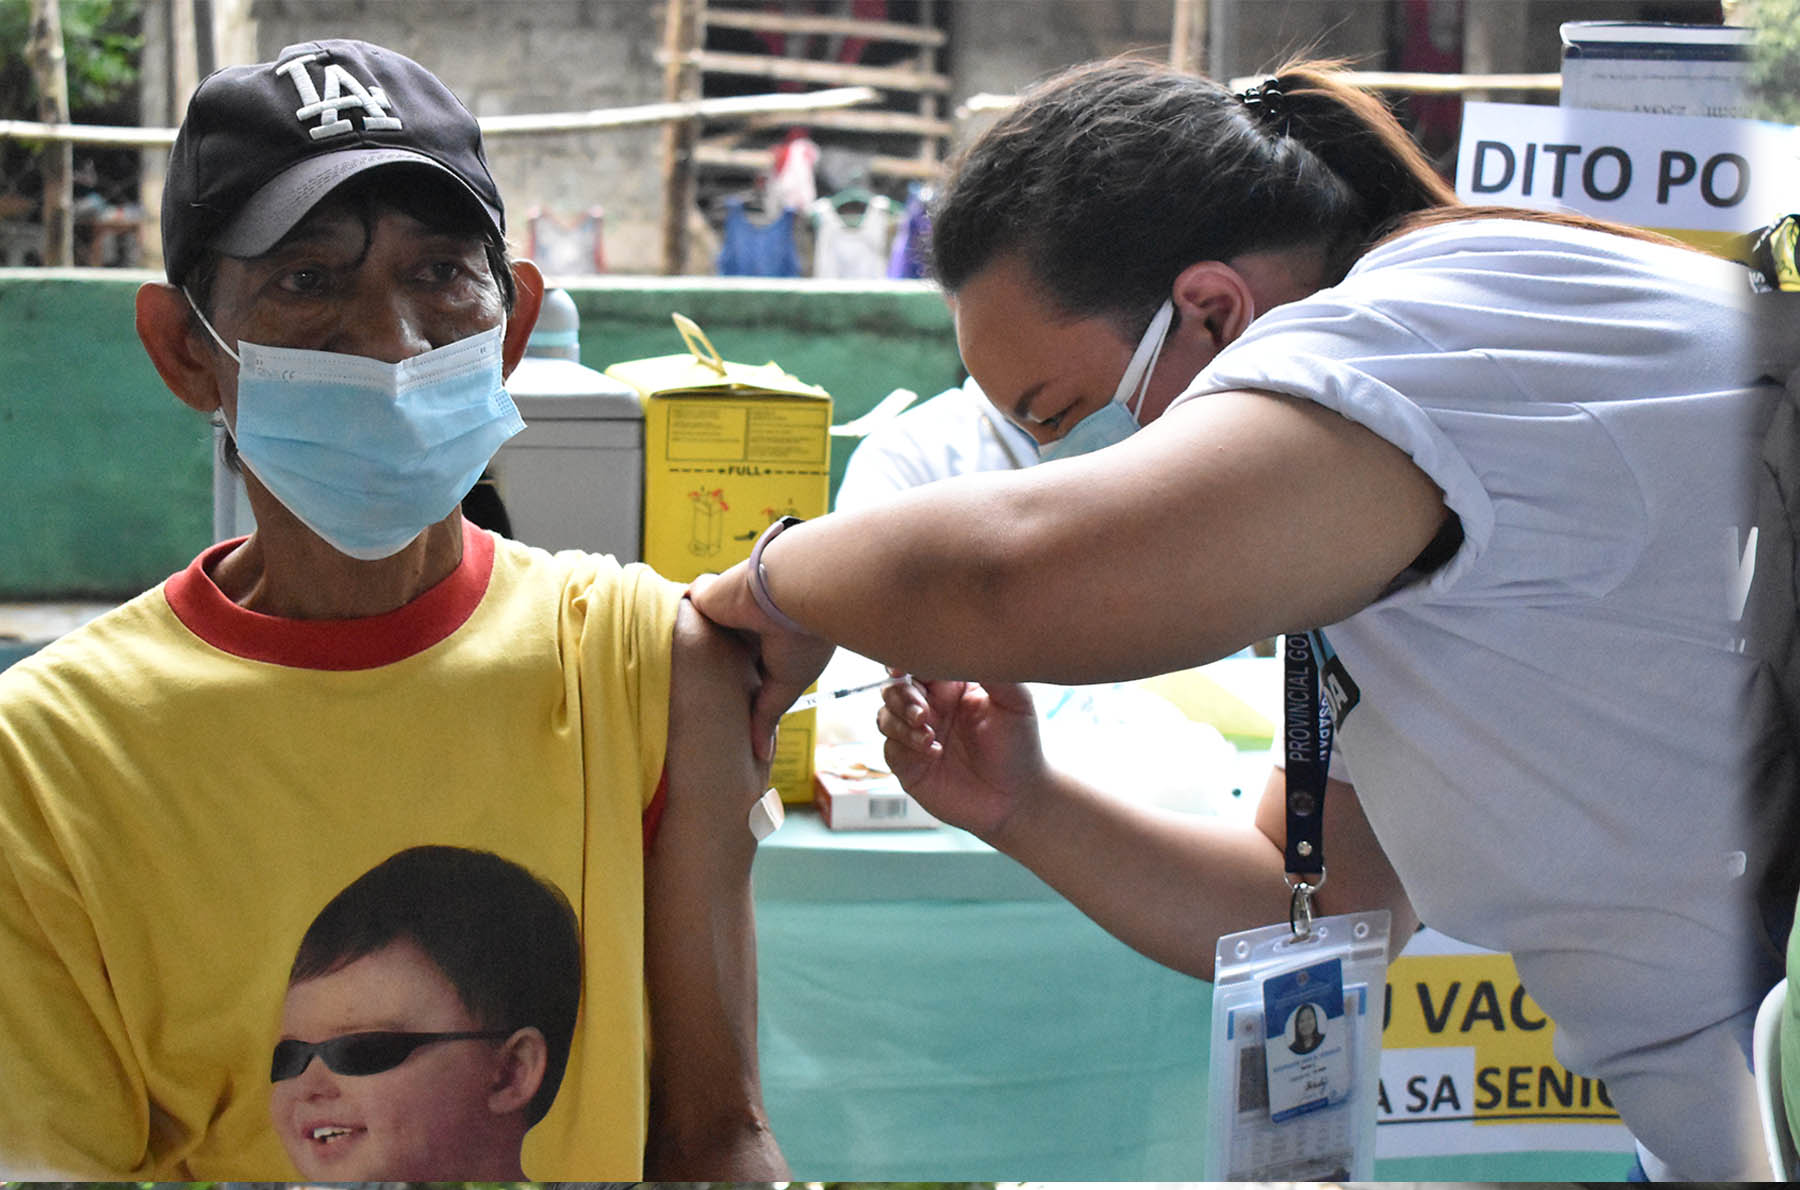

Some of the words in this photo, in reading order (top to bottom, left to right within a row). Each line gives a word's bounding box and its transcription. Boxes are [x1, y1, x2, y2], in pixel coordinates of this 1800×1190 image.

[276, 54, 402, 140] LA
[1471, 140, 1632, 202] DITO
[1656, 150, 1750, 208] PO
[728, 466, 761, 476] FULL
[1287, 666, 1312, 763] PROVINCIAL
[1405, 1074, 1461, 1113] SA
